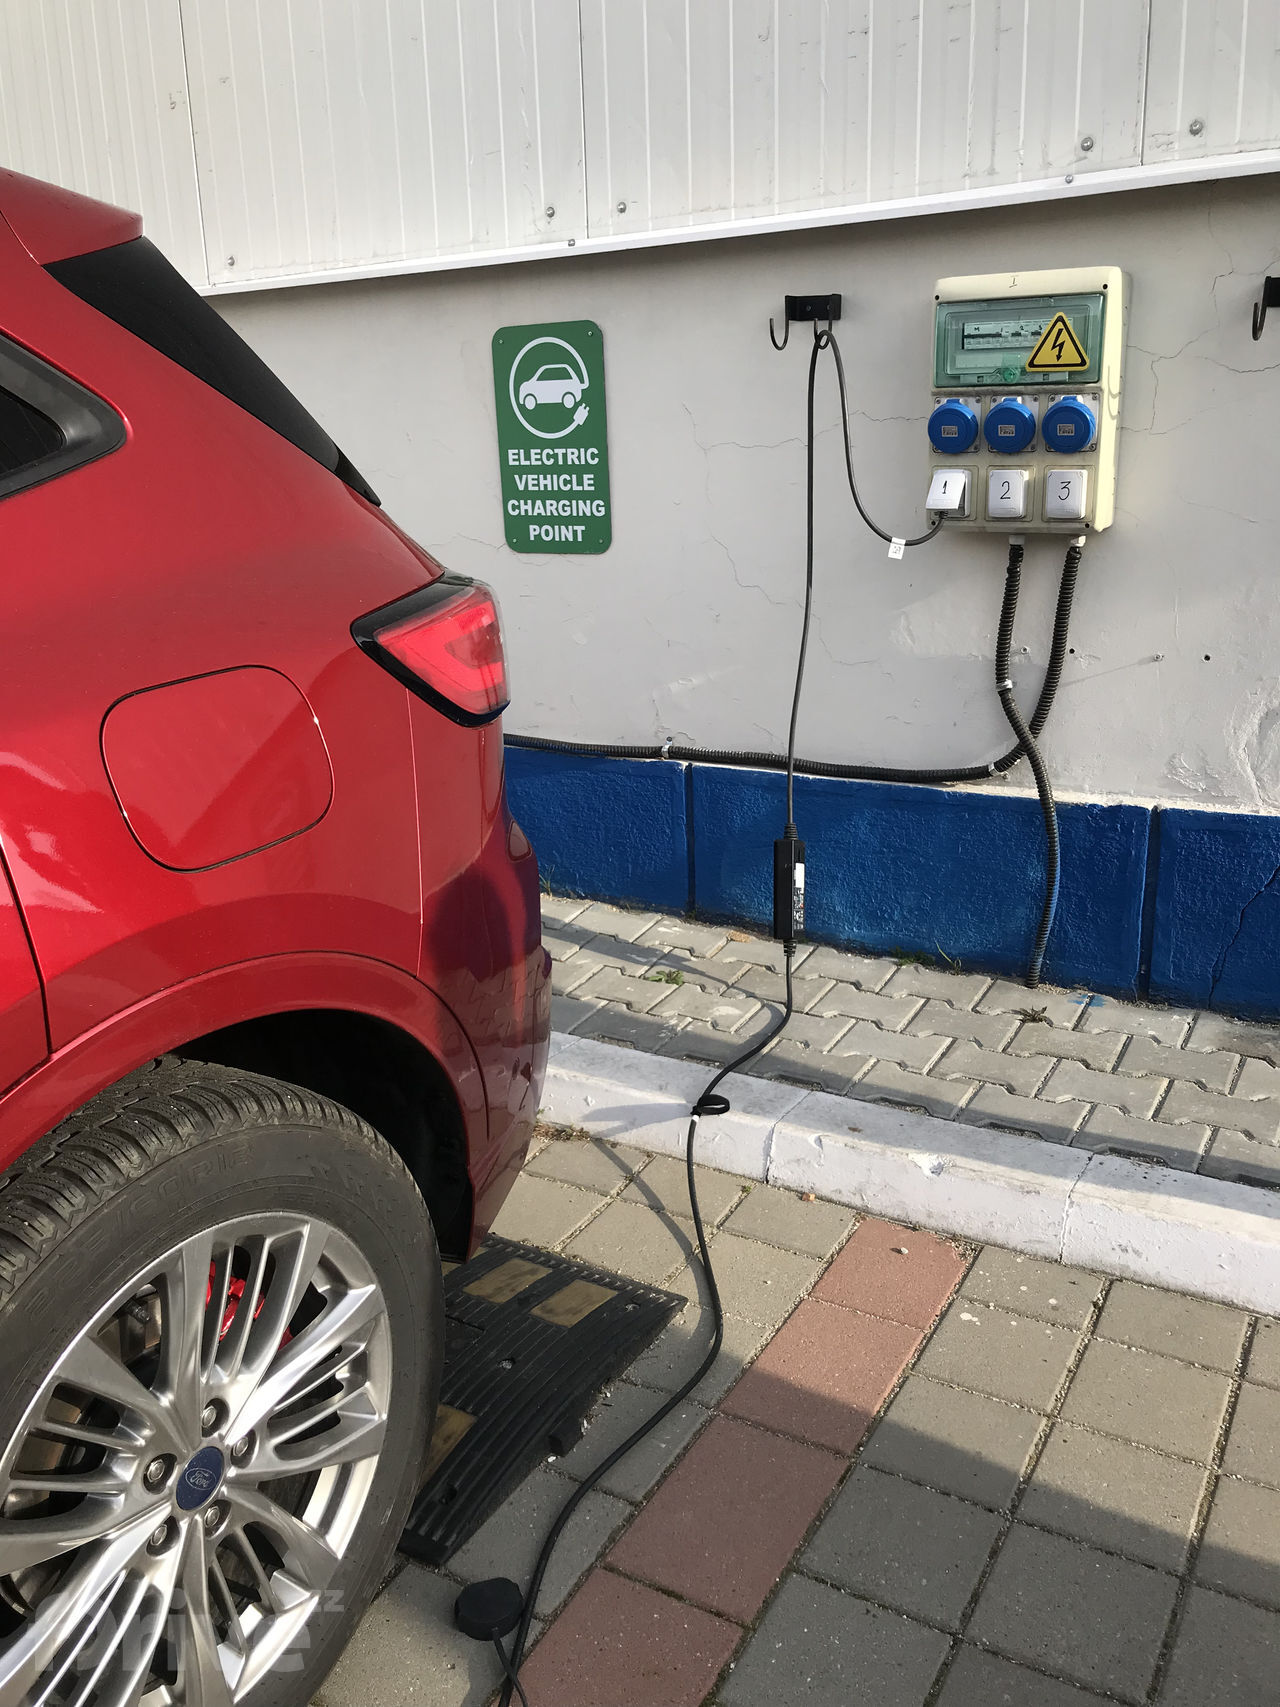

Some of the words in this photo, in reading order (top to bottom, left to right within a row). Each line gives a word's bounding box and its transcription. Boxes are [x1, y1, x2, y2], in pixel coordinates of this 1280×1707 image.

[507, 447, 600, 466] ELECTRIC
[513, 473, 595, 491] VEHICLE
[942, 480, 948, 495] 1
[1000, 480, 1011, 500] 2
[1058, 480, 1072, 501] 3
[507, 499, 606, 517] CHARGING
[528, 525, 586, 542] POINT
[189, 1470, 214, 1489] Ford
